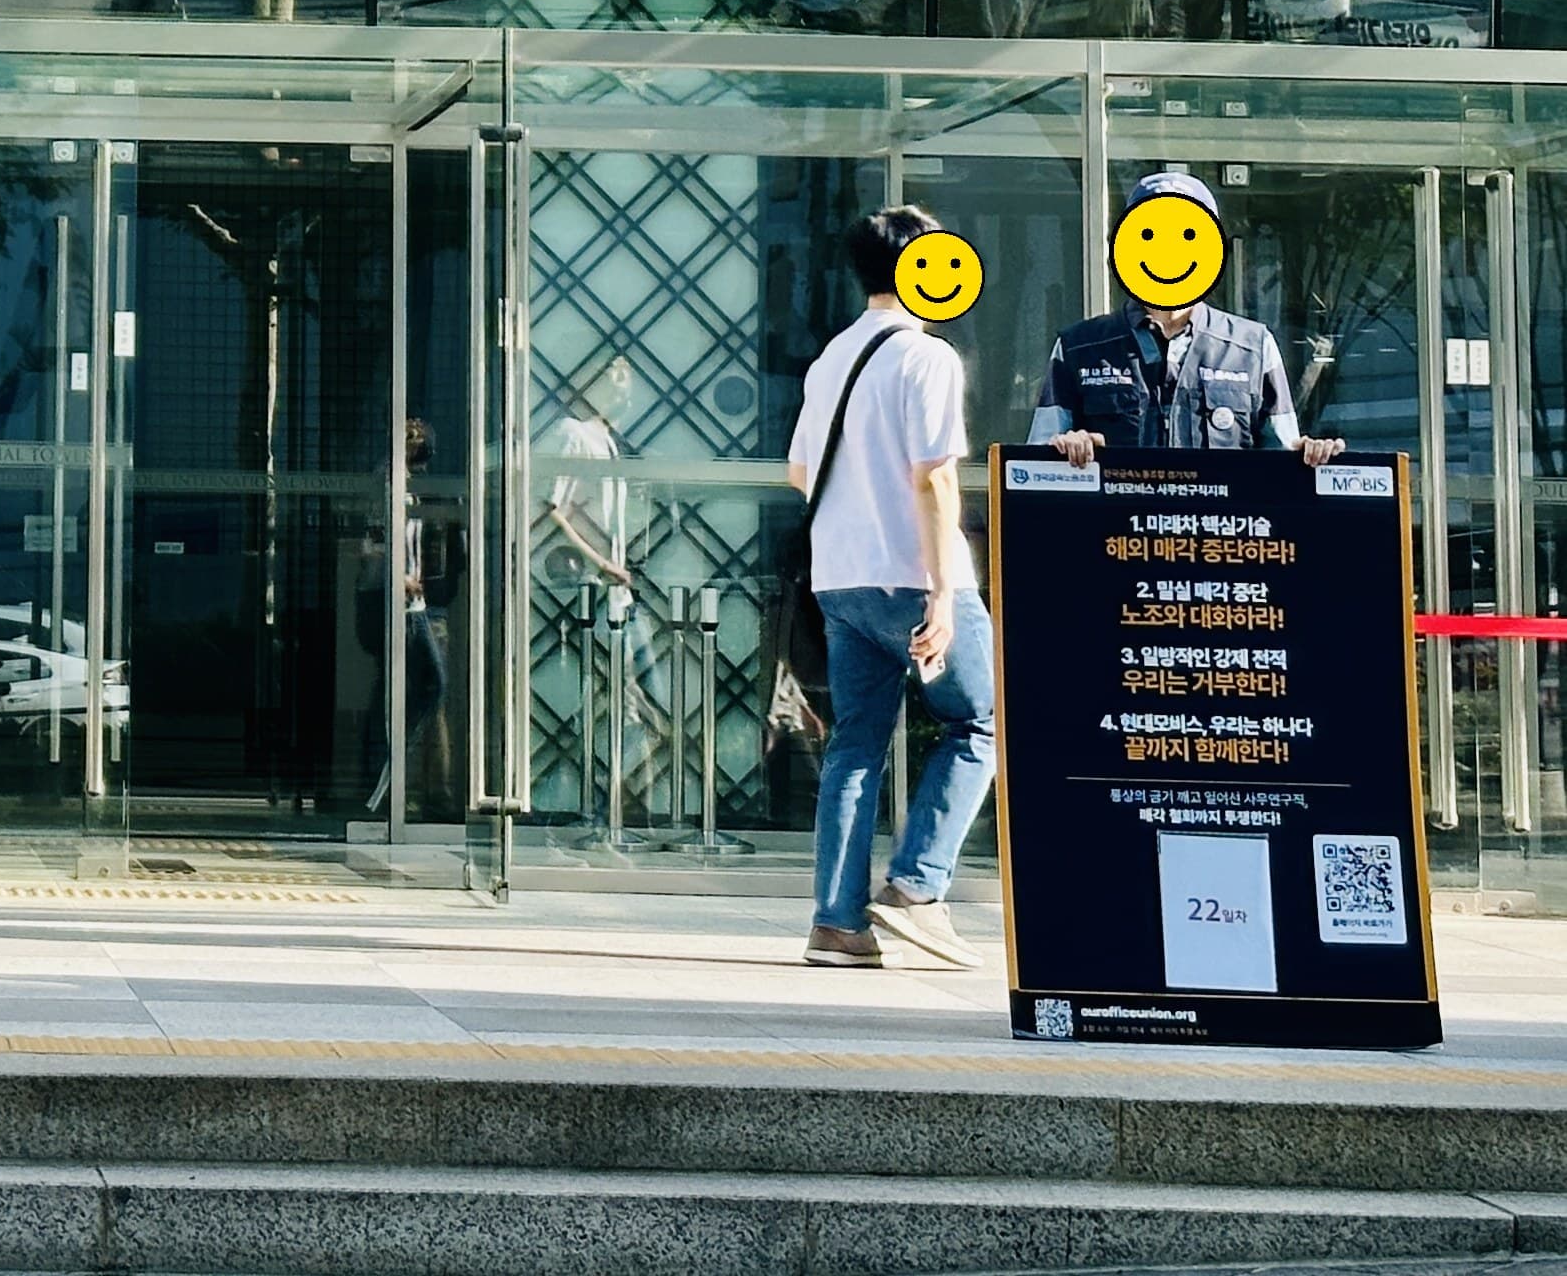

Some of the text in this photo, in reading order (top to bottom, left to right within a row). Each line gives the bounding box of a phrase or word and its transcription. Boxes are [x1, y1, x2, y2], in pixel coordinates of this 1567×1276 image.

[1104, 482, 1229, 498] 현대모비스 사무연구직지회
[1332, 476, 1388, 493] MOBIS
[1130, 514, 1272, 537] 1. 미래차 핵심기술
[1105, 536, 1296, 565] 해외 매각 중단하라!
[1136, 580, 1270, 603] 2. 밀실 매각 중단
[1120, 603, 1285, 631] 노조와 대화하라!
[1120, 646, 1288, 671] 3. 일방적인 강제 전적
[1121, 669, 1287, 698] 우리는 거부한다!
[1099, 713, 1314, 738] 4. 현대모비스, 우리는 하나다
[1124, 736, 1290, 765] 끝까지 함께한다!
[1139, 807, 1166, 823] 매각
[1187, 897, 1248, 924] 22일차
[1080, 1005, 1197, 1023] ourofficeunion.org
